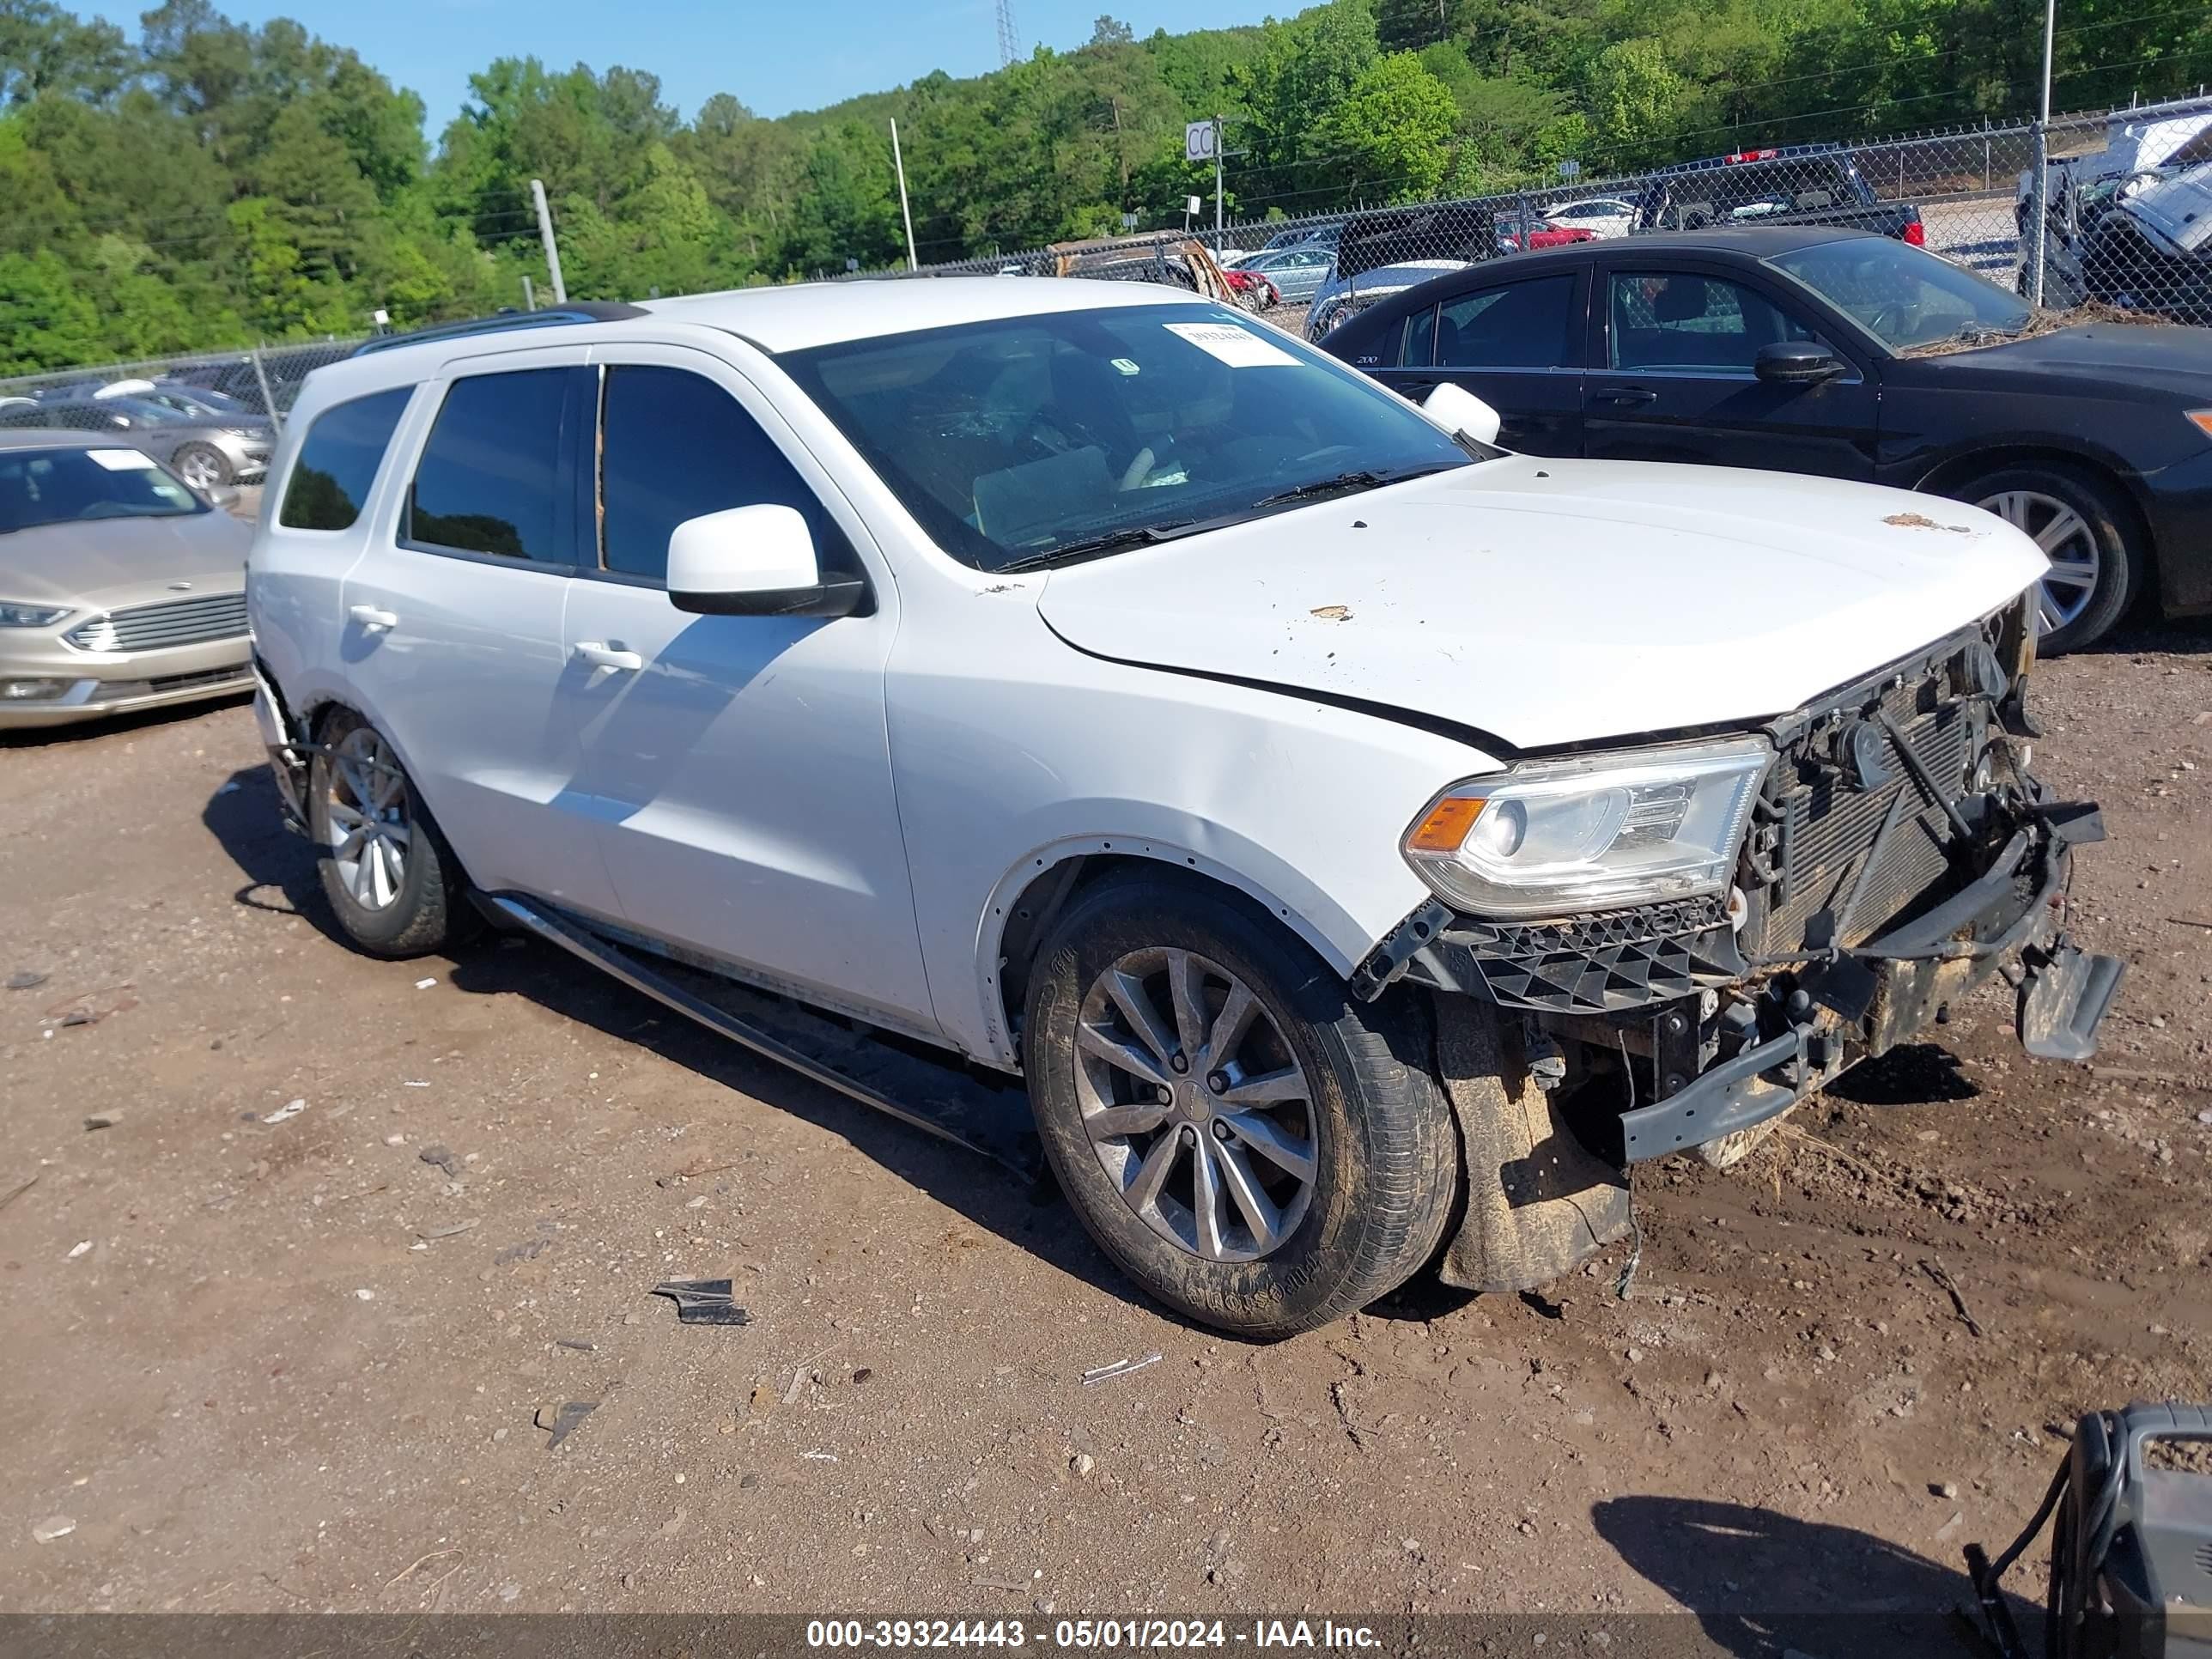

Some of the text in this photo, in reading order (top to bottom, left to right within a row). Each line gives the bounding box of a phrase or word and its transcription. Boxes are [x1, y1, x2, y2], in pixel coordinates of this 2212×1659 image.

[1188, 127, 1212, 155] CC
[1571, 163, 1577, 173] A
[1356, 356, 1378, 364] 200
